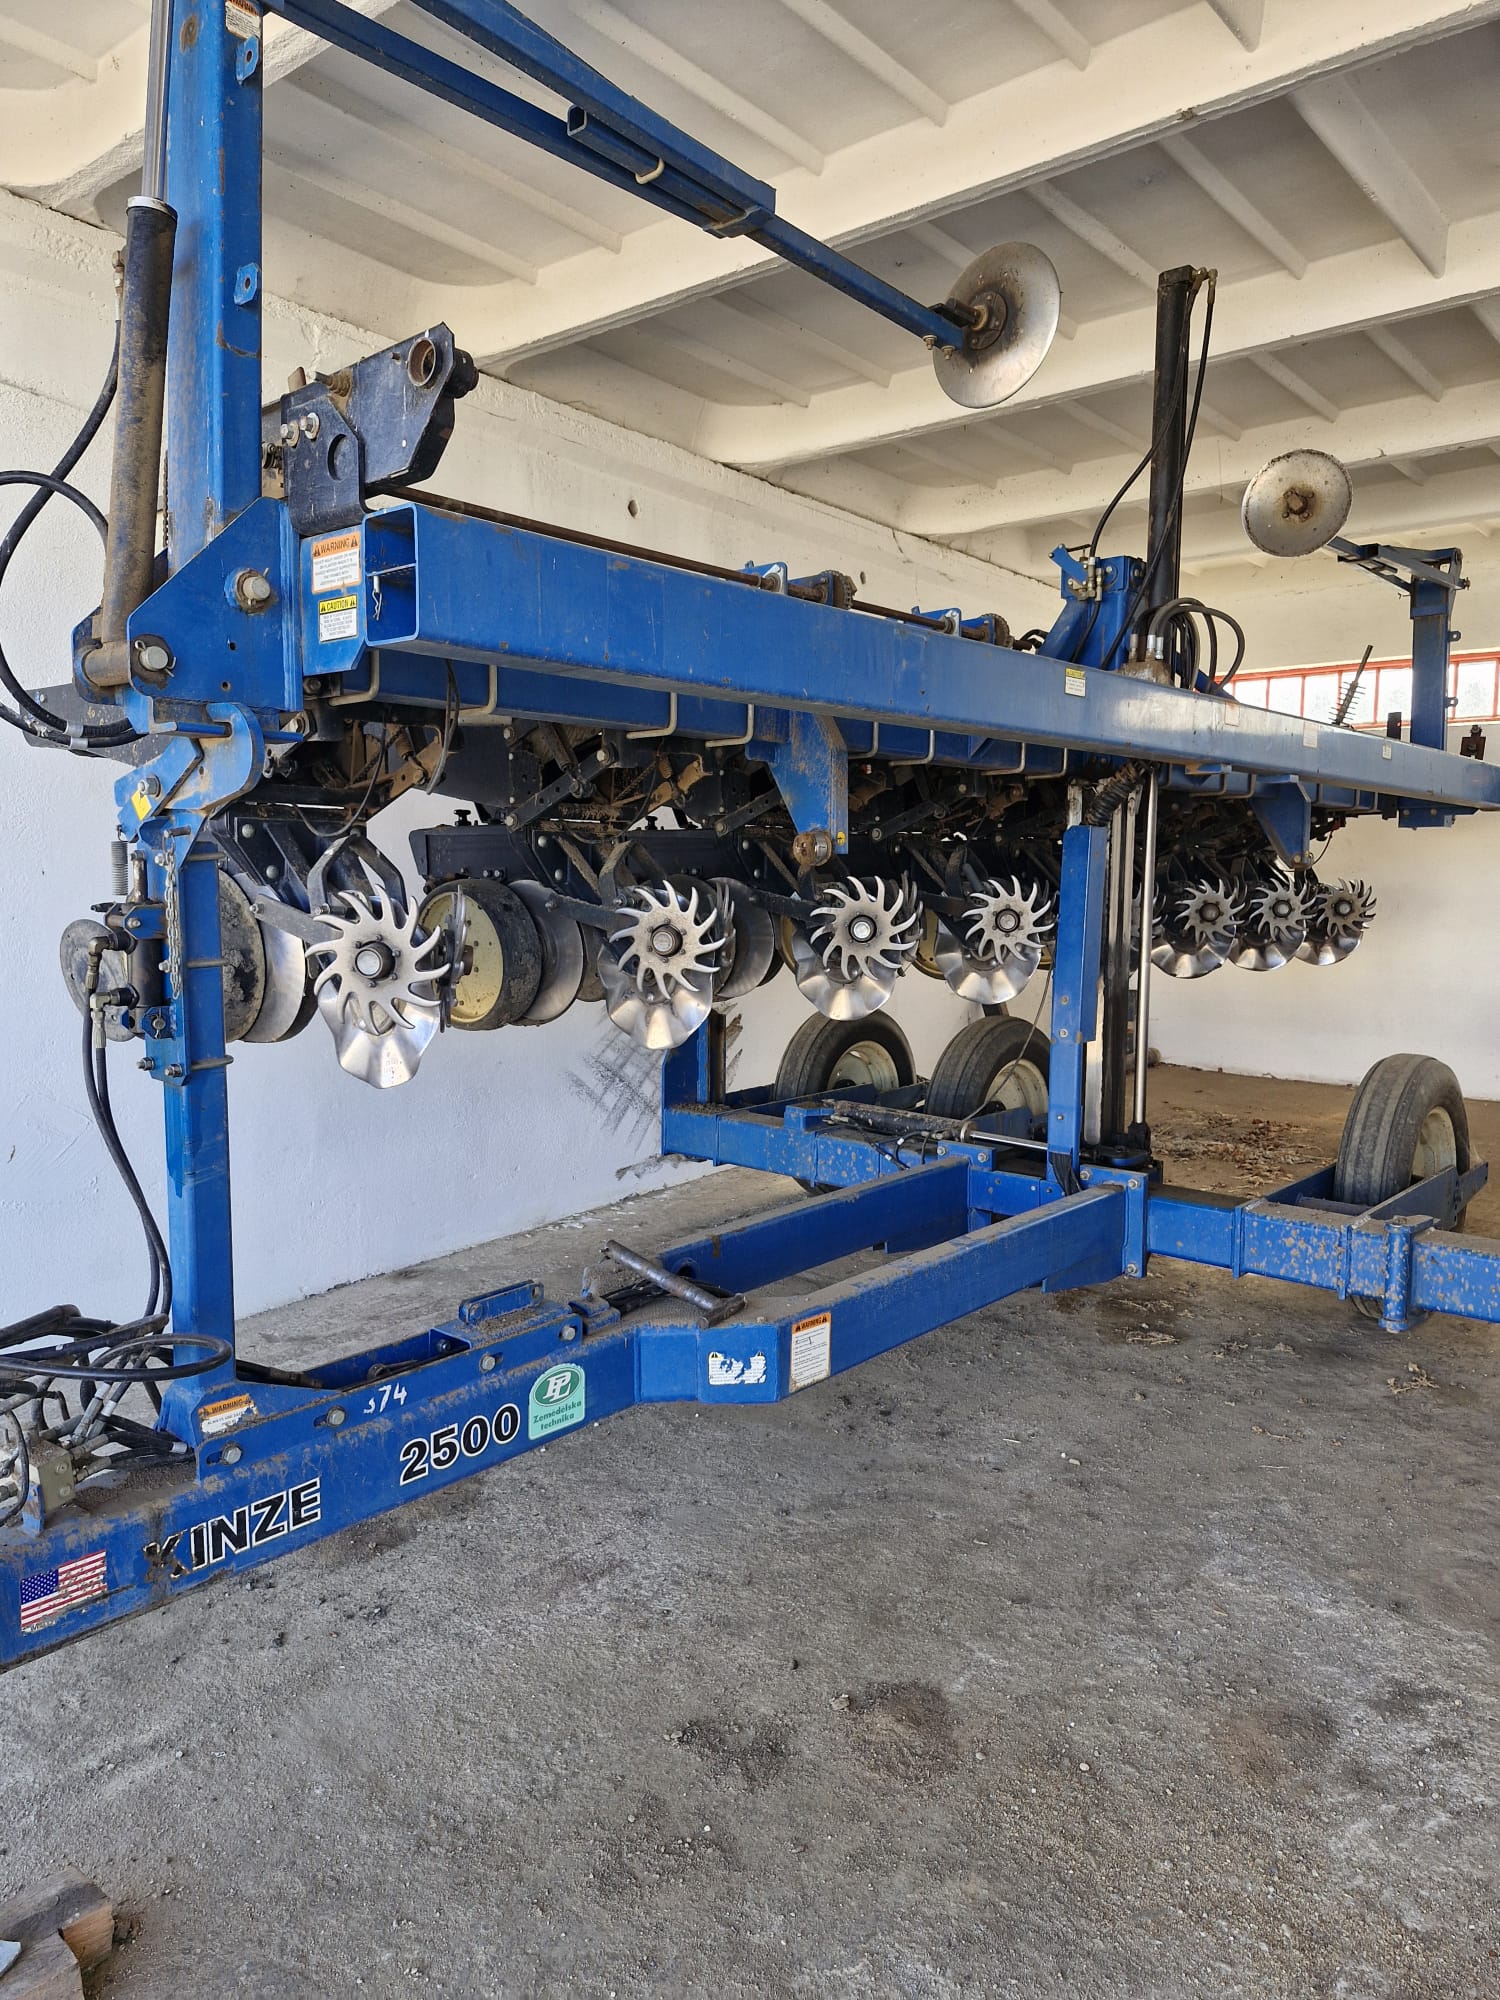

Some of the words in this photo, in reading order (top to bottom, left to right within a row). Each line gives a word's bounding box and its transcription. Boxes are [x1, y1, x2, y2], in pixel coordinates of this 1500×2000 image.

[320, 537, 350, 554] WARNING
[326, 599, 349, 611] CAUTION
[800, 1316, 822, 1330] WARNING
[211, 1398, 243, 1414] WARNING
[540, 1413, 575, 1430] technika
[400, 1403, 521, 1487] 2500
[142, 1477, 322, 1580] KINZE
